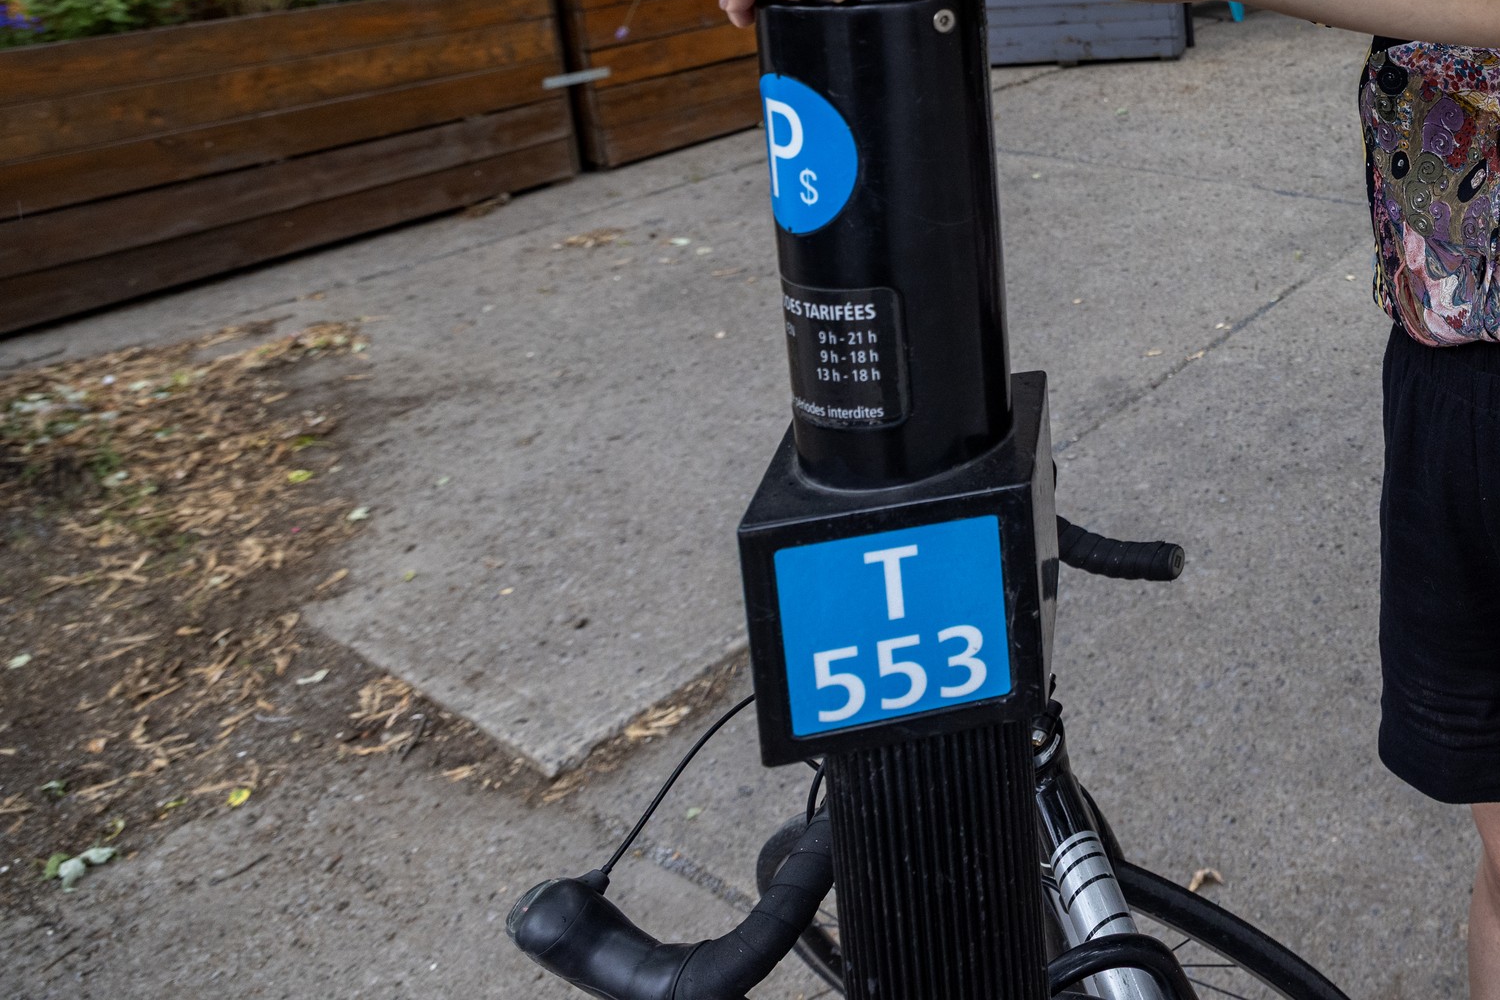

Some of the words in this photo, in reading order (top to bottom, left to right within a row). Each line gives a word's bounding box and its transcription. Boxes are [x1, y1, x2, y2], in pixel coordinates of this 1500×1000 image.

[765, 96, 804, 199] P
[799, 167, 819, 207] $
[803, 301, 877, 321] TARIFÉES
[827, 404, 885, 419] interdites
[863, 544, 919, 621] T
[813, 624, 988, 722] 553
